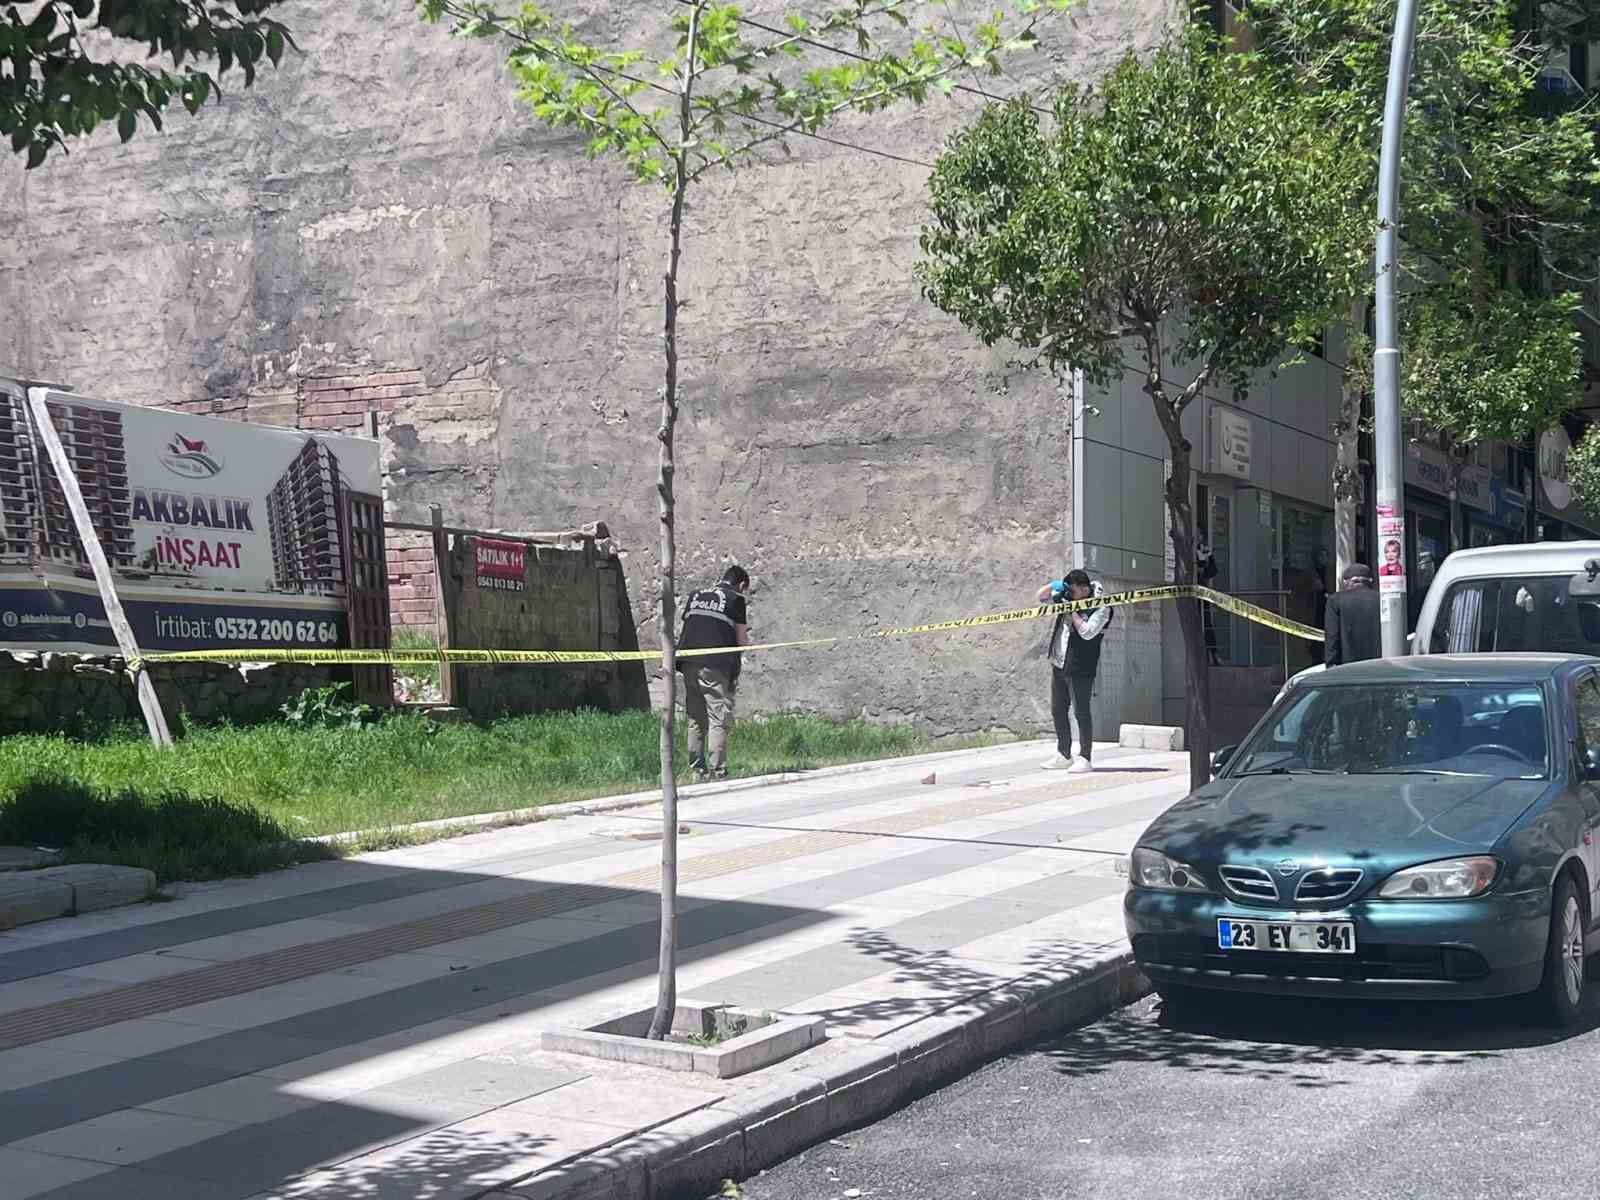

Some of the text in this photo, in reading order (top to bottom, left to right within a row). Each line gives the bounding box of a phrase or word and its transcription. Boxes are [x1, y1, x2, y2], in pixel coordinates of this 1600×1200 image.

[131, 488, 254, 532] AKBALIK
[155, 535, 242, 573] İNŞAAT
[155, 611, 337, 643] İrtibat: 0532 200 62 64
[1232, 924, 1351, 950] 23 EY 341
